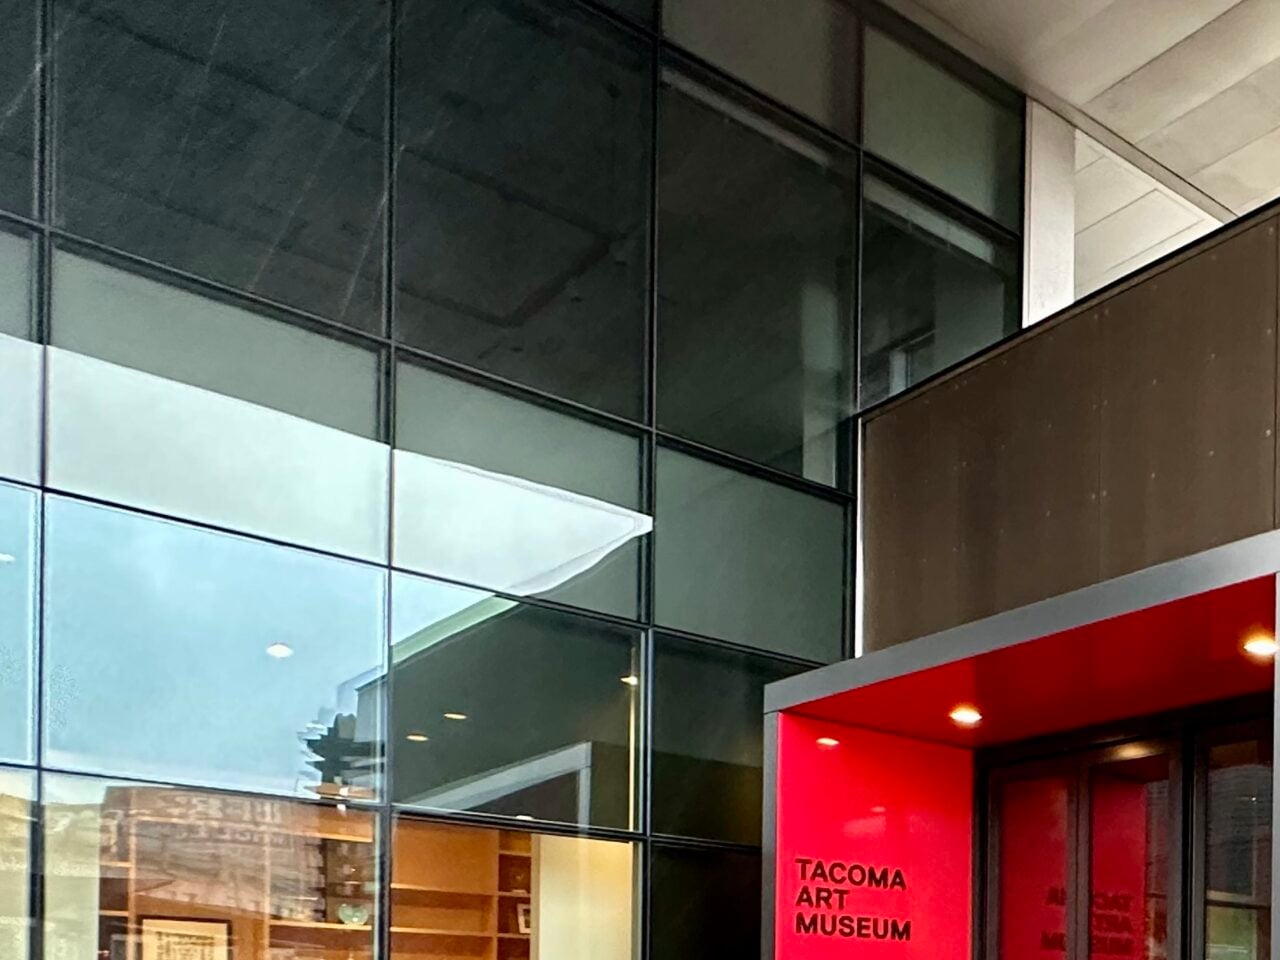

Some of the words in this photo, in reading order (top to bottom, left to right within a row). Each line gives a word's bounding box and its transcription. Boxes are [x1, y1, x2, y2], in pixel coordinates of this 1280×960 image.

[795, 857, 907, 891] TACOMA
[795, 885, 850, 911] ART
[795, 912, 912, 942] MUSEUM
